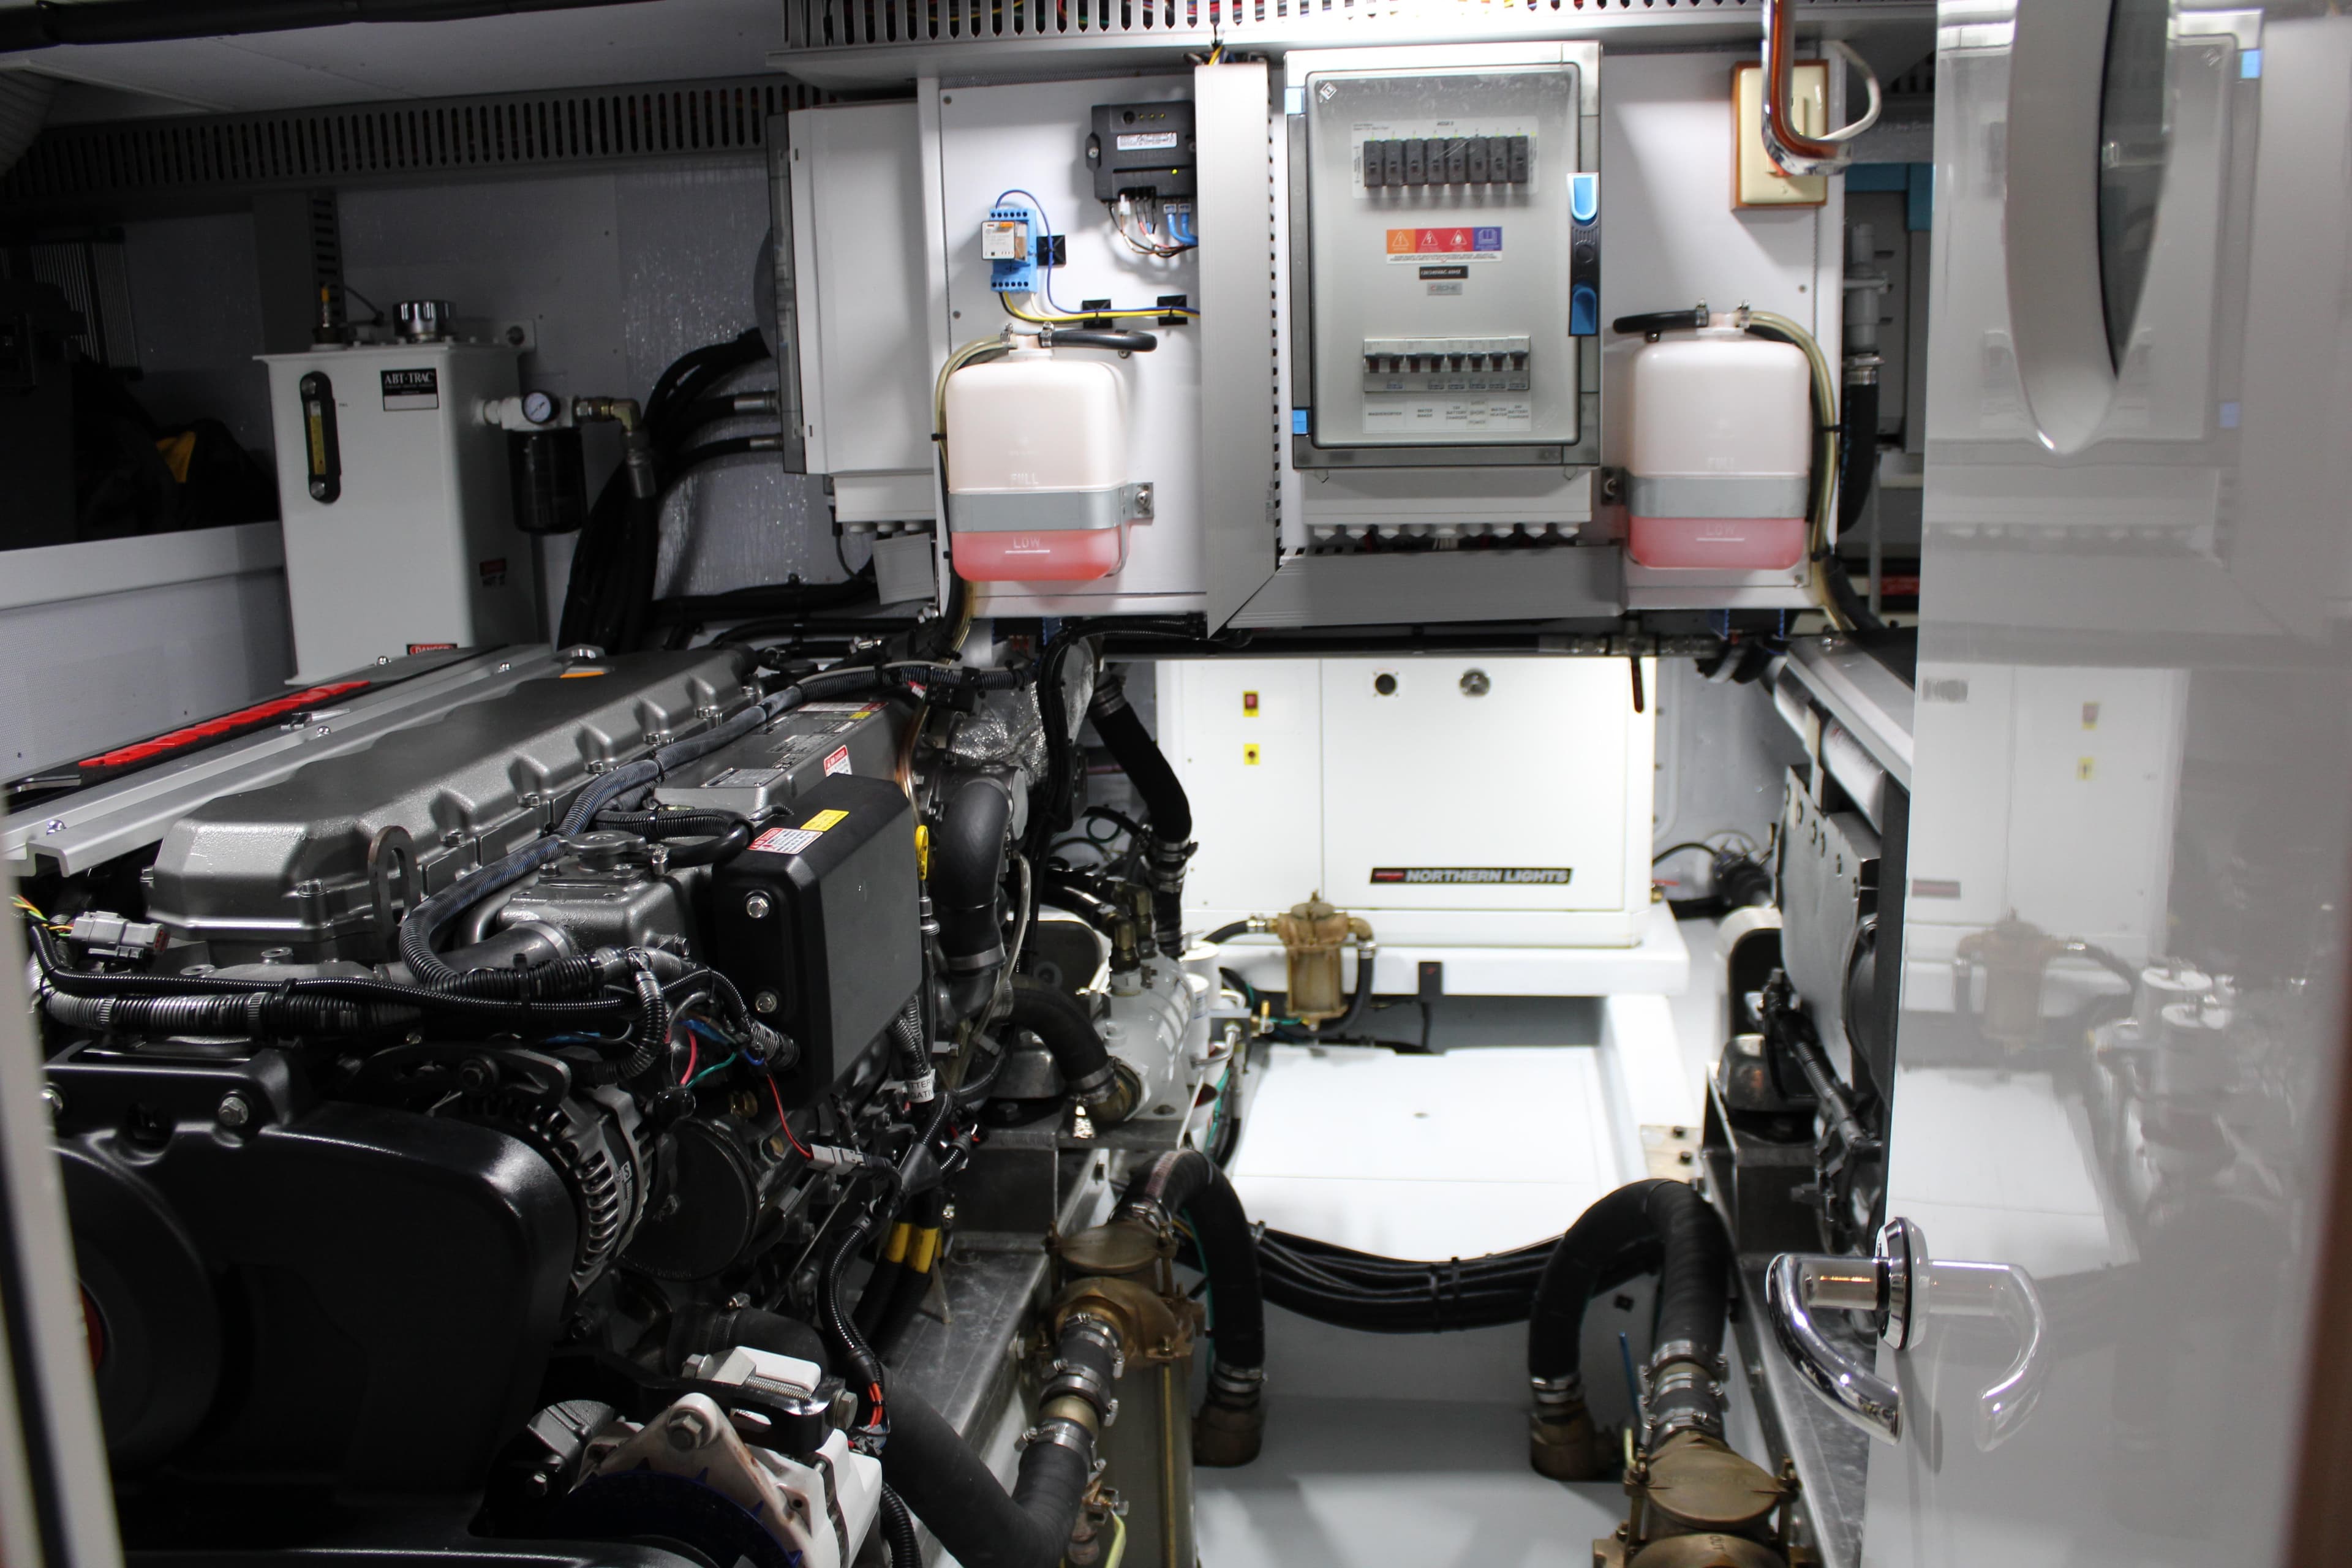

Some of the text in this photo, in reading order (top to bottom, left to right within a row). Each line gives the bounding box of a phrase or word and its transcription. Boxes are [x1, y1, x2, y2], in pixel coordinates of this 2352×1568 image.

[1013, 538, 1040, 549] LOW
[1406, 869, 1569, 883] NORTHERN LIGHTS
